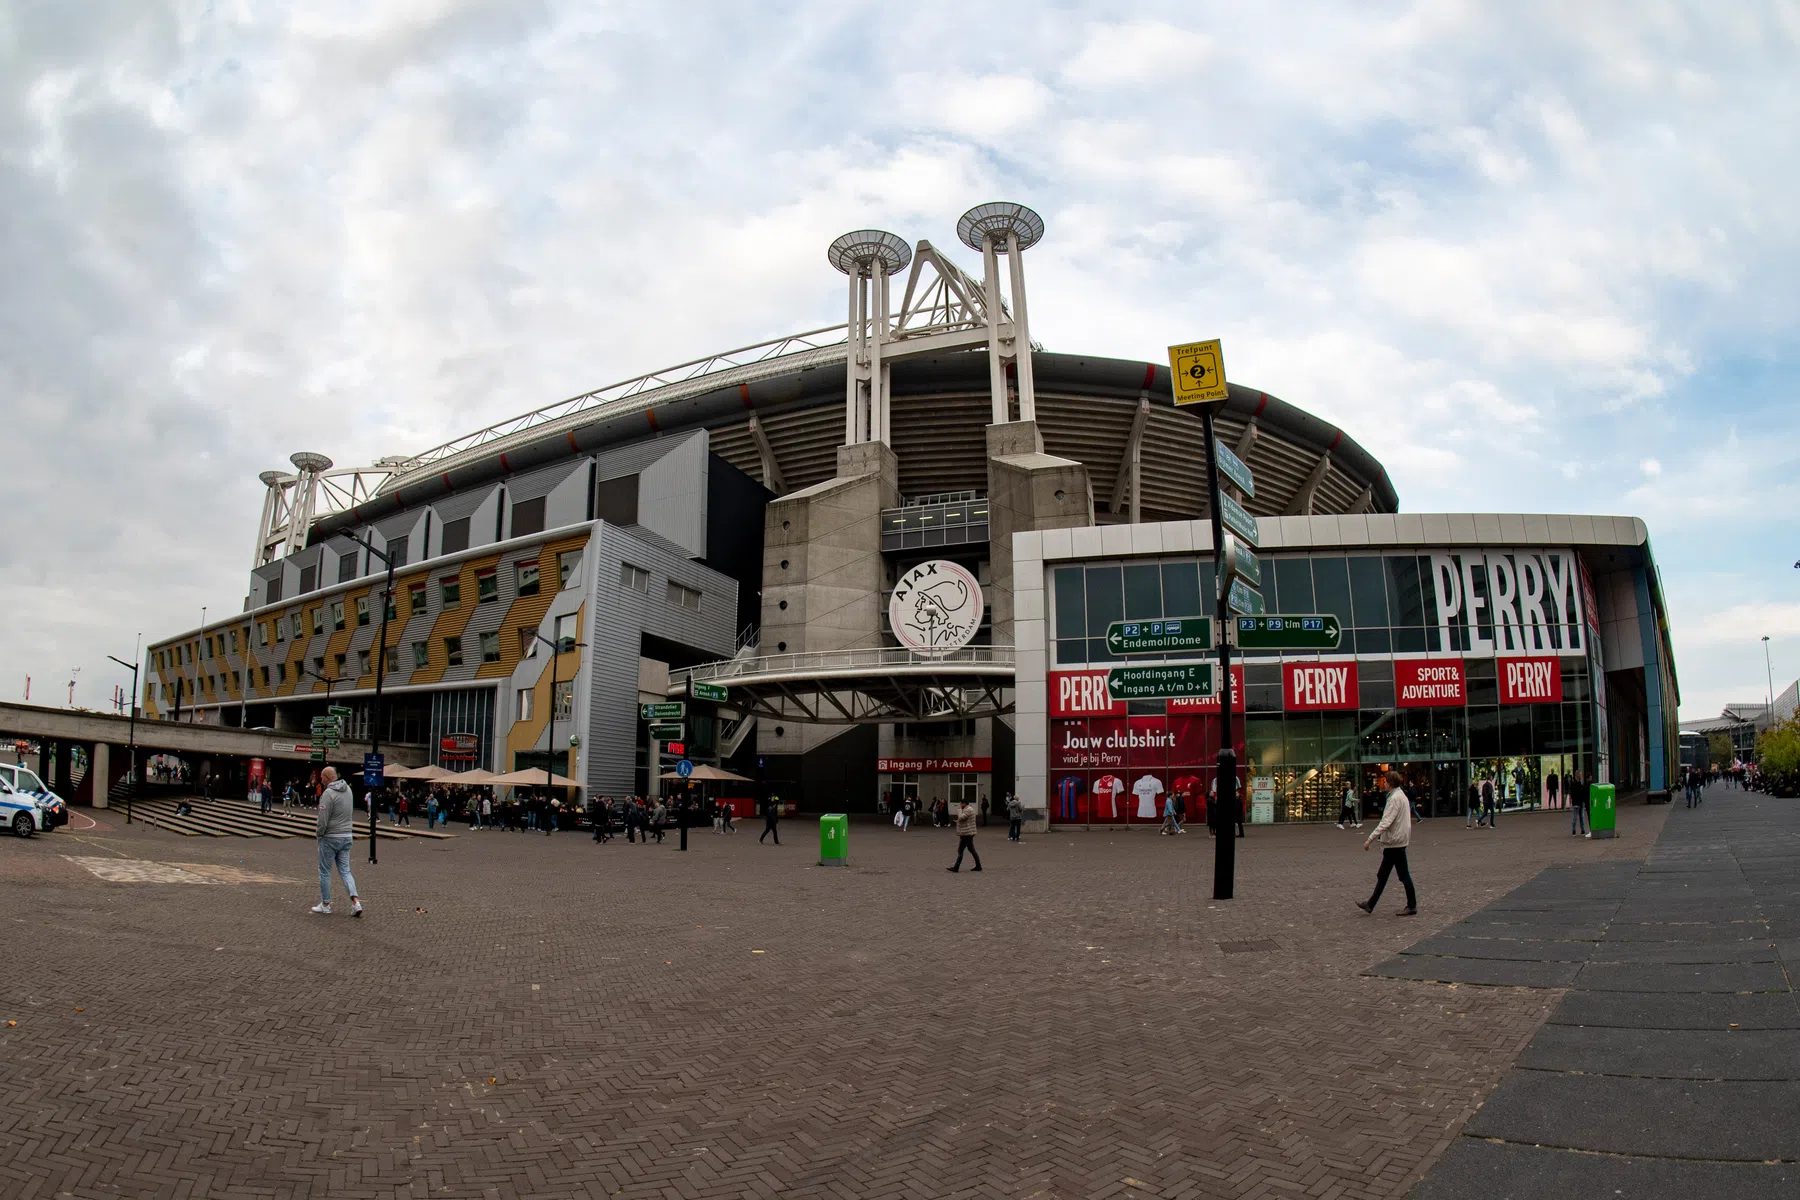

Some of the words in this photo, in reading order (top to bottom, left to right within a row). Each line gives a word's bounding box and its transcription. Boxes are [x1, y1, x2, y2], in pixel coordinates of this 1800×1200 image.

[1176, 344, 1213, 355] Trefpunt
[1194, 366, 1202, 377] 2
[1177, 393, 1205, 401] Meeting
[1206, 390, 1225, 398] Point
[895, 563, 938, 602] AJAX
[1431, 552, 1569, 651] PERRY
[1125, 625, 1138, 635] P2
[1153, 624, 1160, 633] P
[1241, 621, 1254, 629] P3
[1268, 620, 1282, 629] P9
[1303, 620, 1321, 629] P17
[1123, 636, 1201, 648] Endemol/Dome
[1123, 670, 1185, 680] Hoofdingang
[1189, 668, 1195, 677] E
[1507, 662, 1552, 698] PERRY
[1123, 684, 1155, 694] Ingang
[1293, 667, 1348, 705] PERRY
[1402, 684, 1460, 699] ADVENTURE
[1063, 731, 1102, 749] Jouw
[1106, 729, 1176, 748] clubshirt
[889, 760, 923, 770] Ingang
[926, 760, 938, 768] P1
[941, 759, 973, 768] ArenA
[1063, 754, 1079, 763] vind
[1080, 754, 1088, 767] je
[1090, 753, 1099, 766] bij
[1101, 752, 1121, 765] Perry
